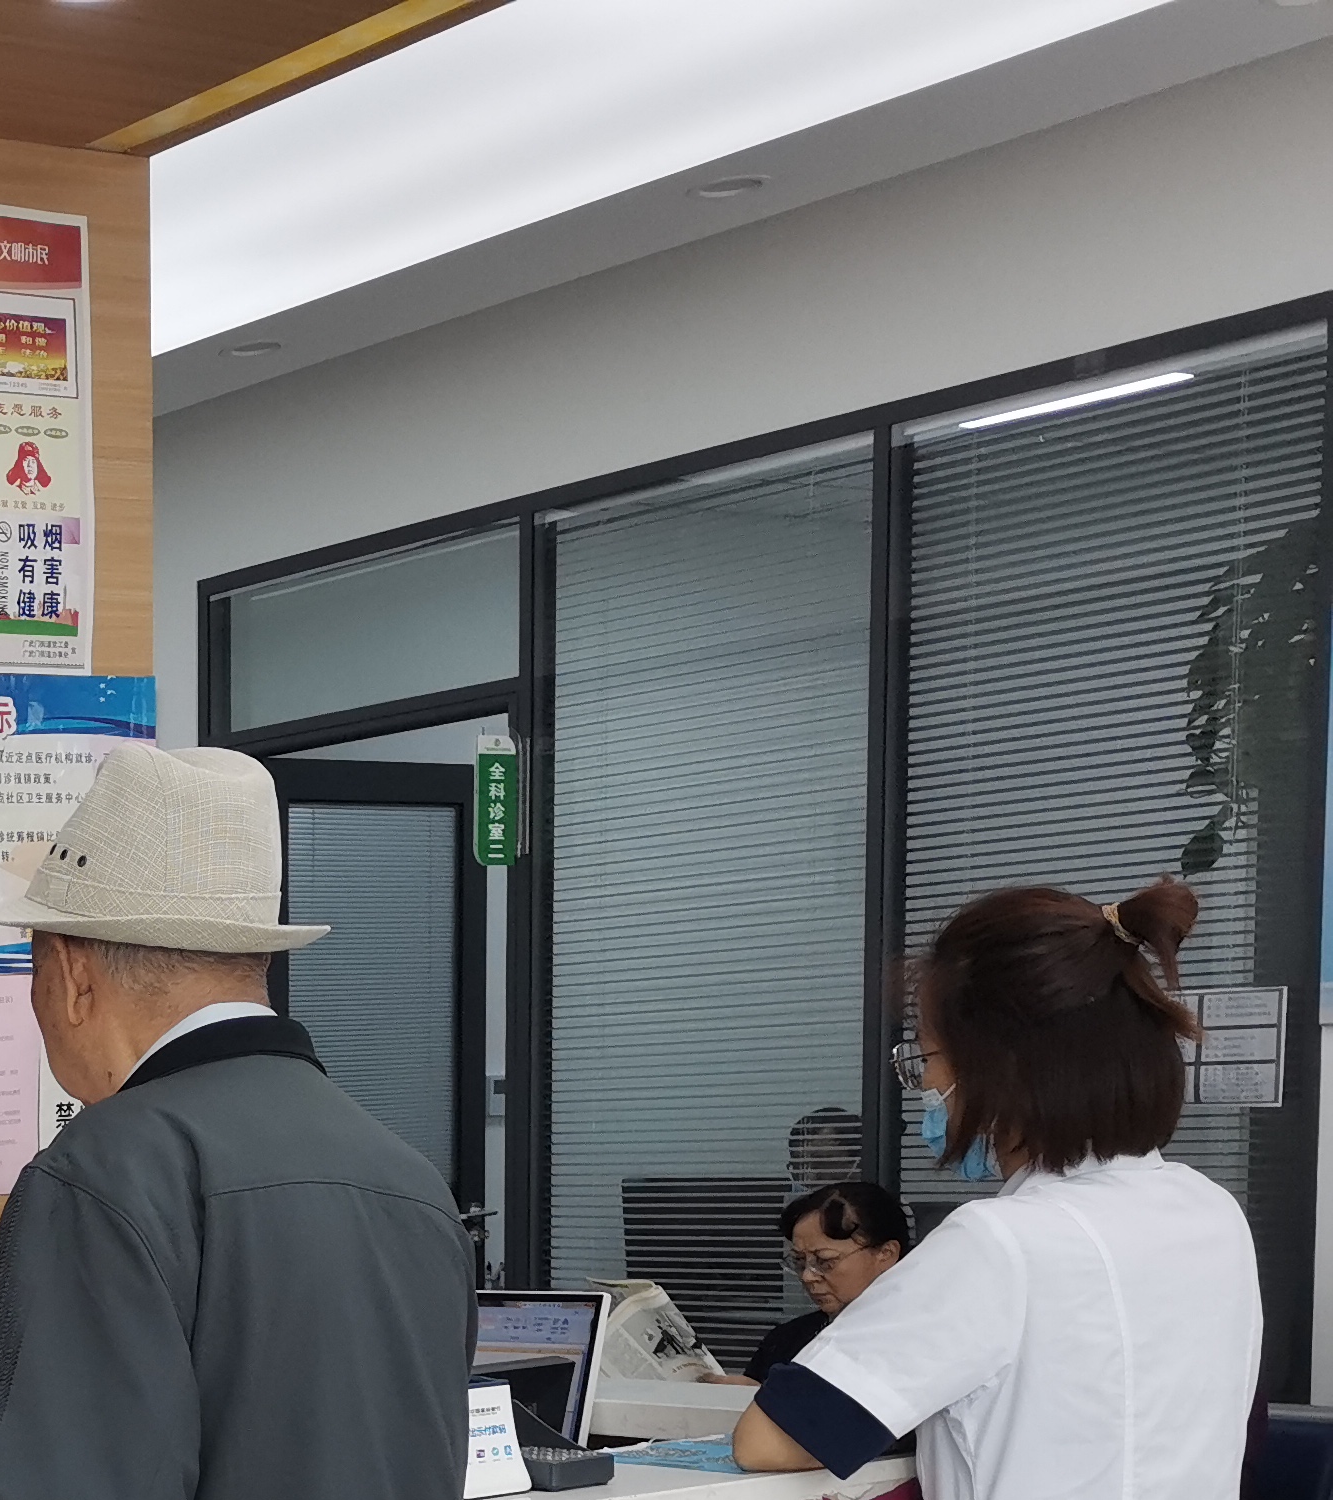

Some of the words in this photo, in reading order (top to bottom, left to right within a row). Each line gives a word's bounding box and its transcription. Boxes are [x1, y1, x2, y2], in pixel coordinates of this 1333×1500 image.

[21, 336, 48, 348] 和谐
[18, 523, 63, 552] 吸烟
[18, 555, 63, 587] 有害
[16, 589, 61, 620] 健康
[488, 762, 506, 858] 全科诊室二
